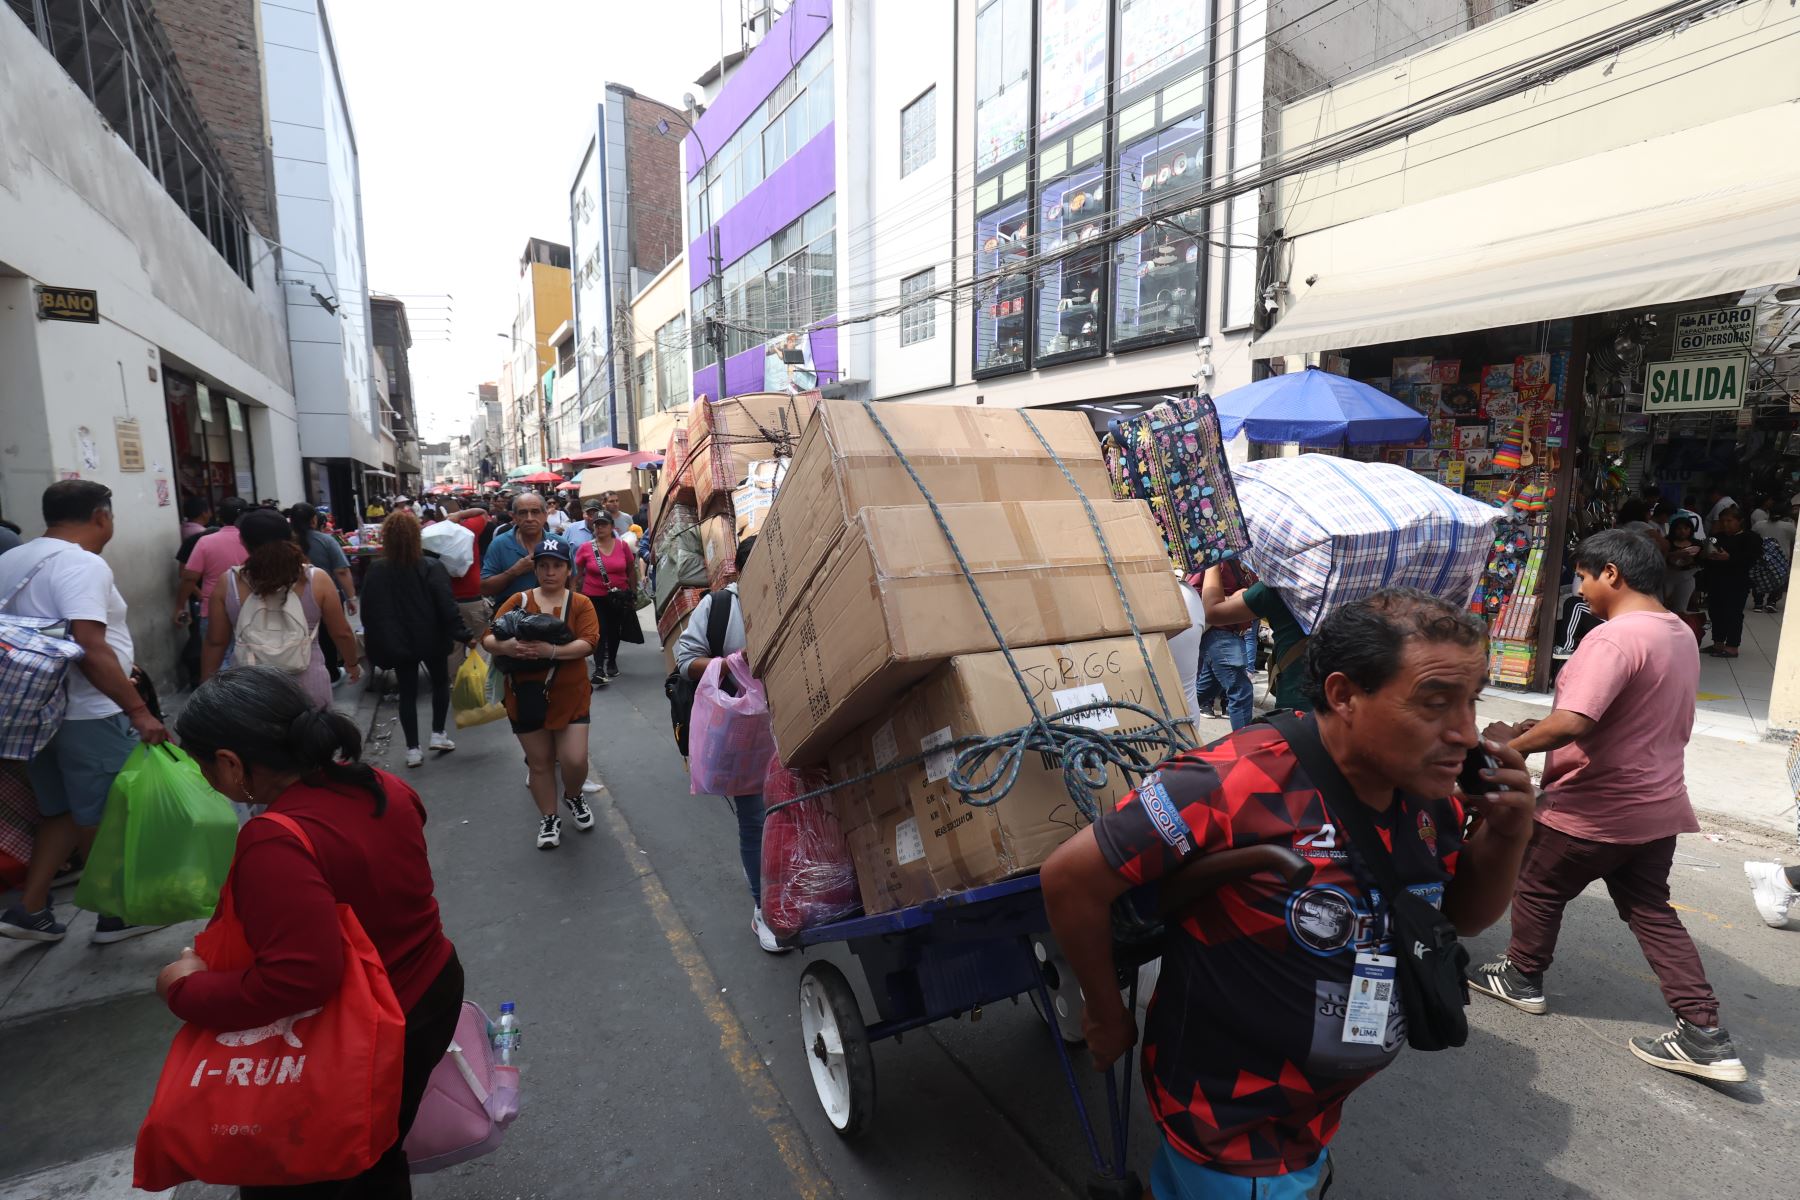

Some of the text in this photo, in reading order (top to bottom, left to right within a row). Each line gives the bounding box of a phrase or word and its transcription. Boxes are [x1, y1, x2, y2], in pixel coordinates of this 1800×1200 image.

[41, 291, 93, 311] BAÑO
[1697, 308, 1751, 327] AFORO
[1680, 324, 1719, 336] CAPACIDAD
[1681, 331, 1750, 348] 60 PERSONAS
[1650, 365, 1736, 404] SALIDA
[543, 539, 559, 551] NY
[1144, 784, 1191, 856] ROQUE
[1359, 1029, 1377, 1037] LIMA
[190, 1054, 306, 1087] I-RUN
